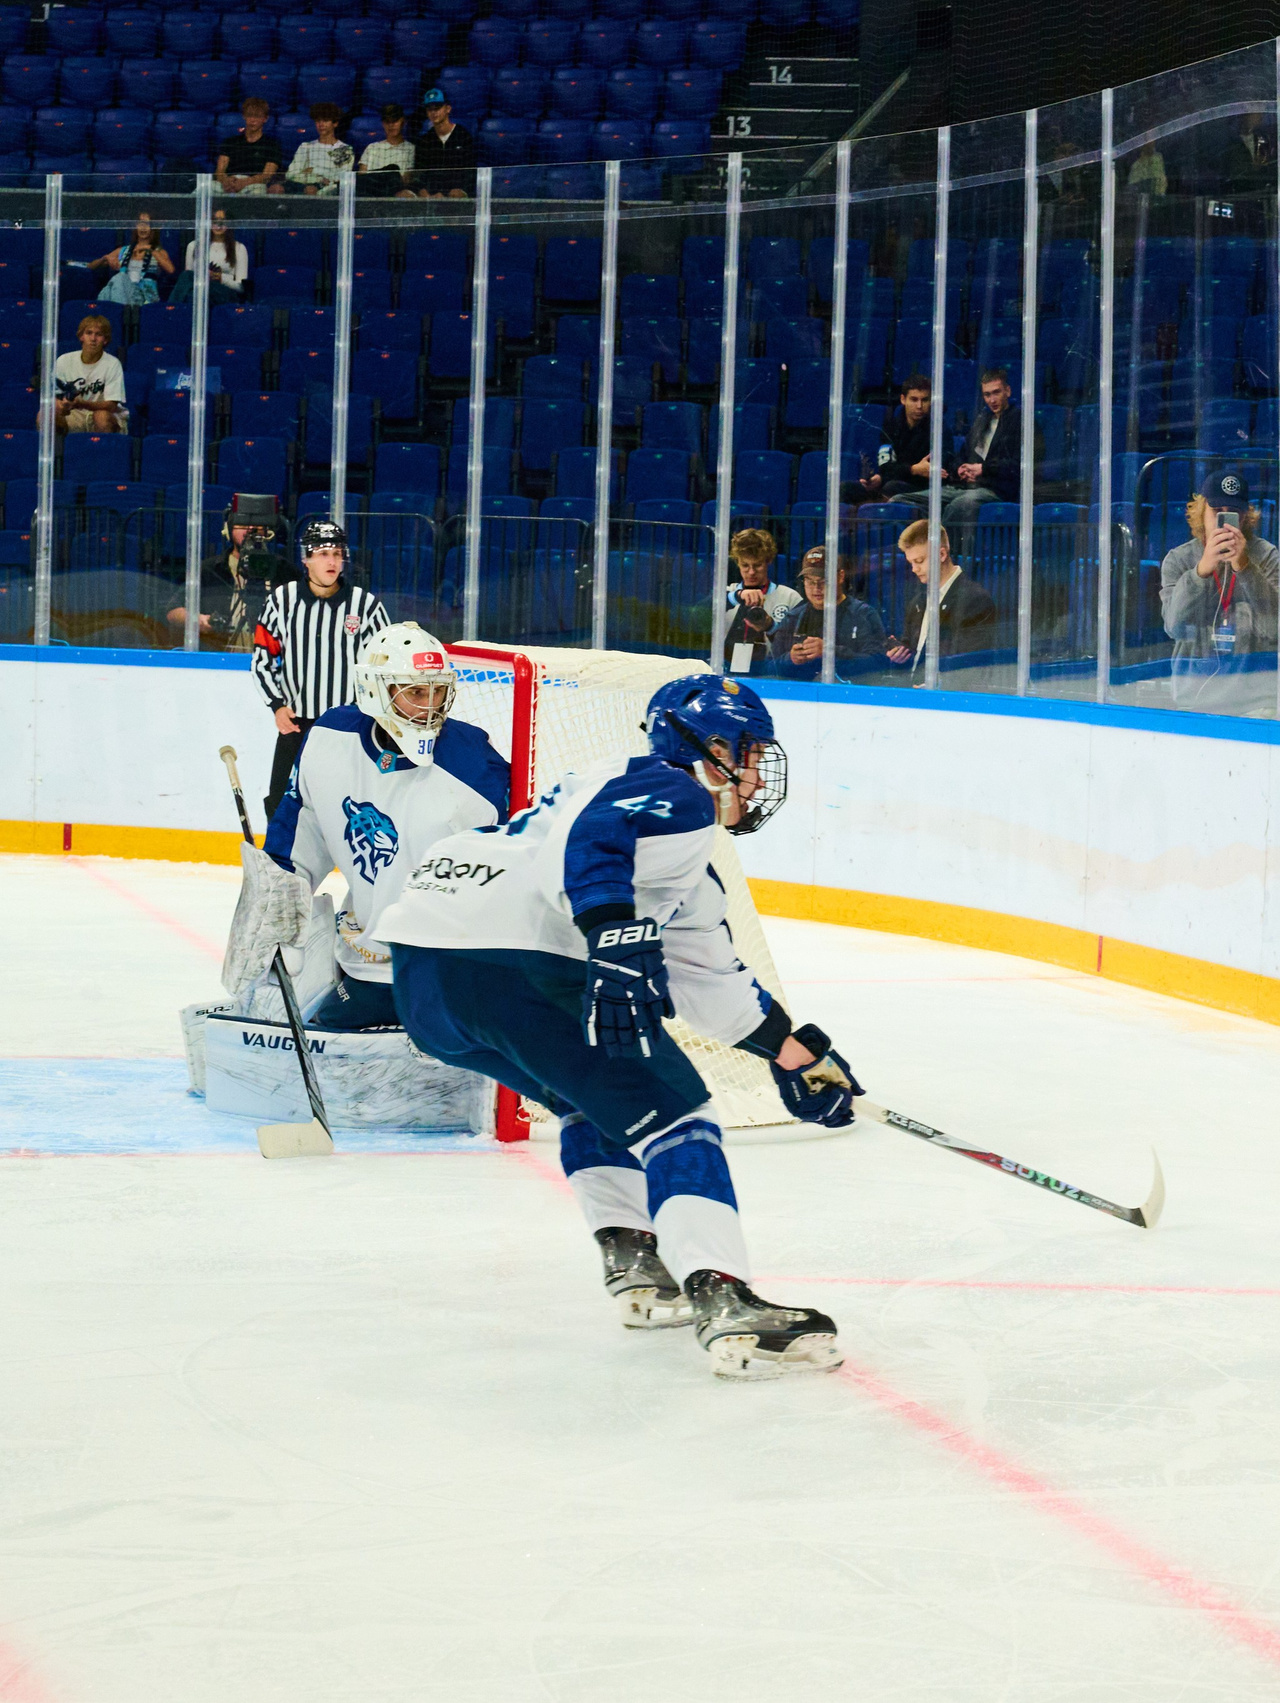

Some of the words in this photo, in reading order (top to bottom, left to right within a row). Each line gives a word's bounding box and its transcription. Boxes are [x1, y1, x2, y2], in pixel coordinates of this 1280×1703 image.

[769, 65, 793, 84] 14
[726, 115, 752, 137] 13
[417, 738, 434, 755] 30
[596, 923, 662, 949] BAU
[1000, 1156, 1081, 1200] SOYUZ
